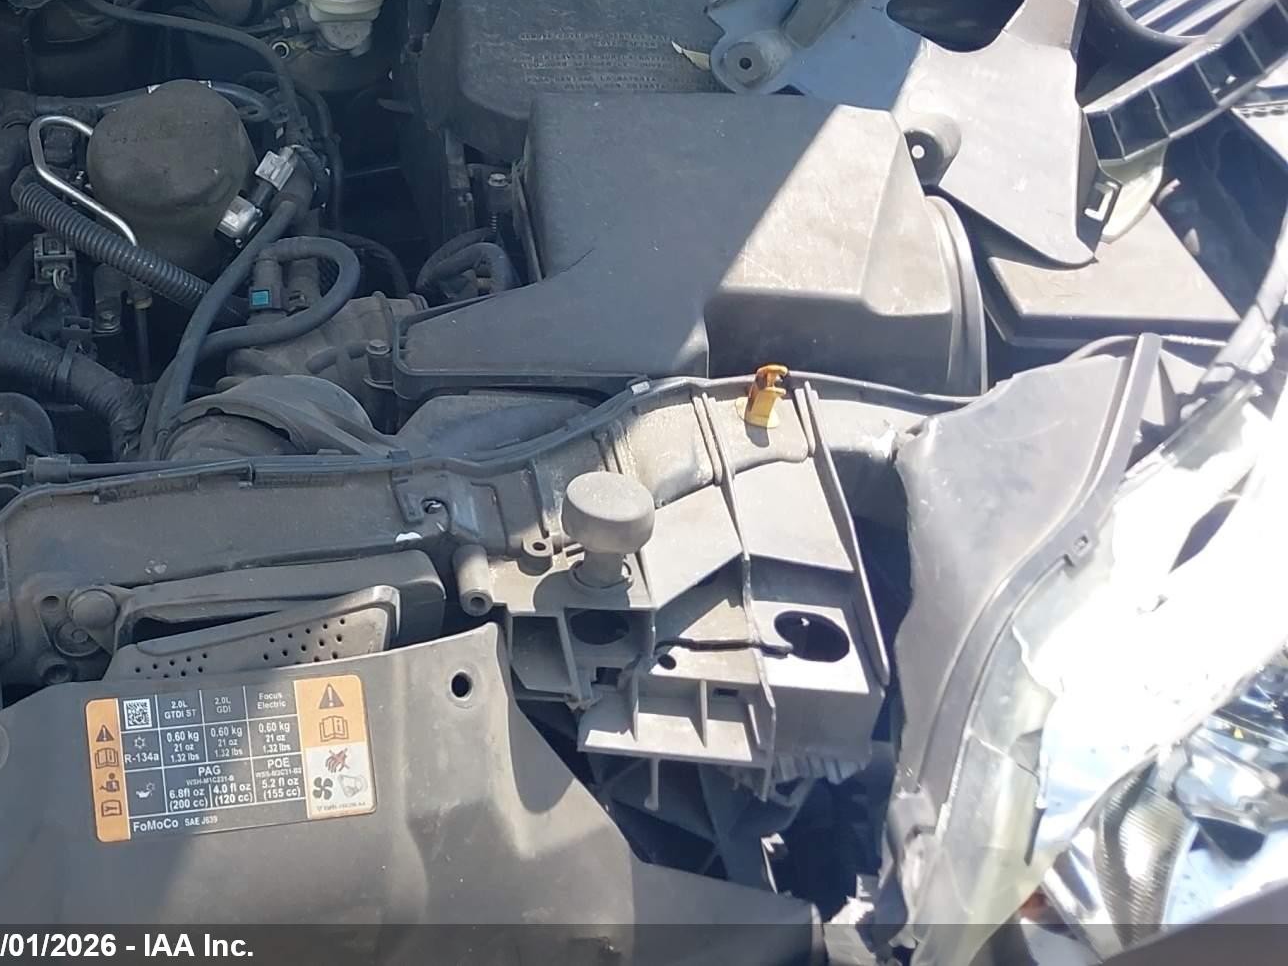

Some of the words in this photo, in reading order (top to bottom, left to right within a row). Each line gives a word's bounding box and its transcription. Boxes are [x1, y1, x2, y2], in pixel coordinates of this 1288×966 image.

[214, 696, 231, 705] 2.0L
[258, 692, 282, 701] Focus
[171, 700, 188, 709] 2.0L
[216, 705, 231, 713] GDI
[257, 700, 286, 710] Electric
[164, 710, 184, 720] GTDI
[185, 709, 197, 717] ST
[210, 726, 229, 738] 0.60
[231, 726, 243, 738] kg
[258, 722, 277, 734] 0.60
[279, 721, 291, 733] kg
[166, 730, 186, 743] 0.60
[187, 730, 200, 742] kg
[265, 734, 274, 743] 21
[276, 734, 286, 742] oz
[174, 743, 182, 752] 21
[218, 739, 226, 747] 21
[228, 738, 238, 746] oz
[214, 748, 230, 758] 1.32
[231, 747, 243, 756] lbs
[262, 744, 278, 754] 1.32
[279, 743, 291, 752] lbs
[124, 752, 160, 764] R-134a
[171, 753, 186, 763] 1.32
[187, 752, 200, 762] lbs
[267, 757, 291, 769] POE
[197, 765, 221, 777] PAG
[213, 783, 228, 795] 4.0
[230, 782, 237, 793] fl
[239, 783, 251, 792] oz
[261, 779, 276, 789] 5.2
[278, 777, 285, 787] fl
[287, 778, 299, 786] oz
[193, 788, 205, 797] oz
[263, 788, 284, 802] (155
[286, 786, 301, 799] cc)
[169, 798, 191, 812] (200
[192, 797, 208, 809] cc)
[215, 794, 235, 807] (120
[238, 792, 253, 803] cc)
[132, 818, 179, 832] FoMoCo
[184, 817, 201, 827] SAE
